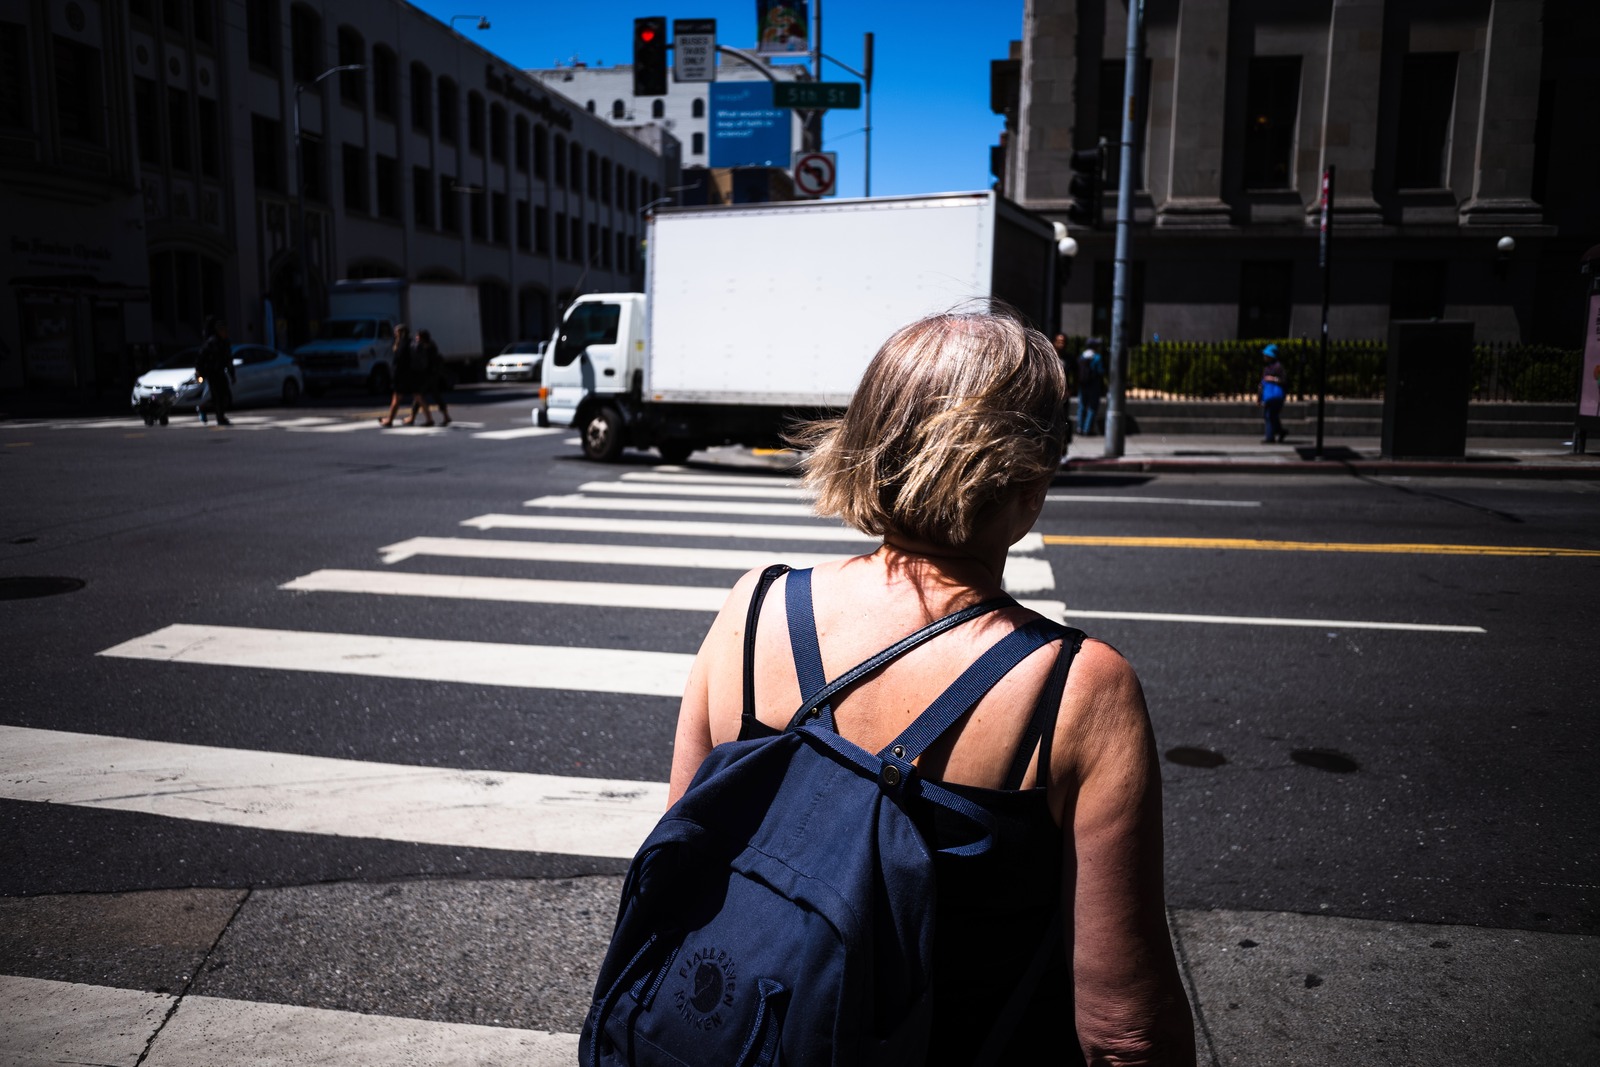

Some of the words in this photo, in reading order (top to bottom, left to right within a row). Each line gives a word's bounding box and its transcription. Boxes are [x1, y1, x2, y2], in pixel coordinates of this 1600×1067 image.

[680, 37, 708, 46] BUSES
[682, 57, 705, 66] ONLY
[788, 88, 817, 102] 5th
[828, 88, 846, 102] St
